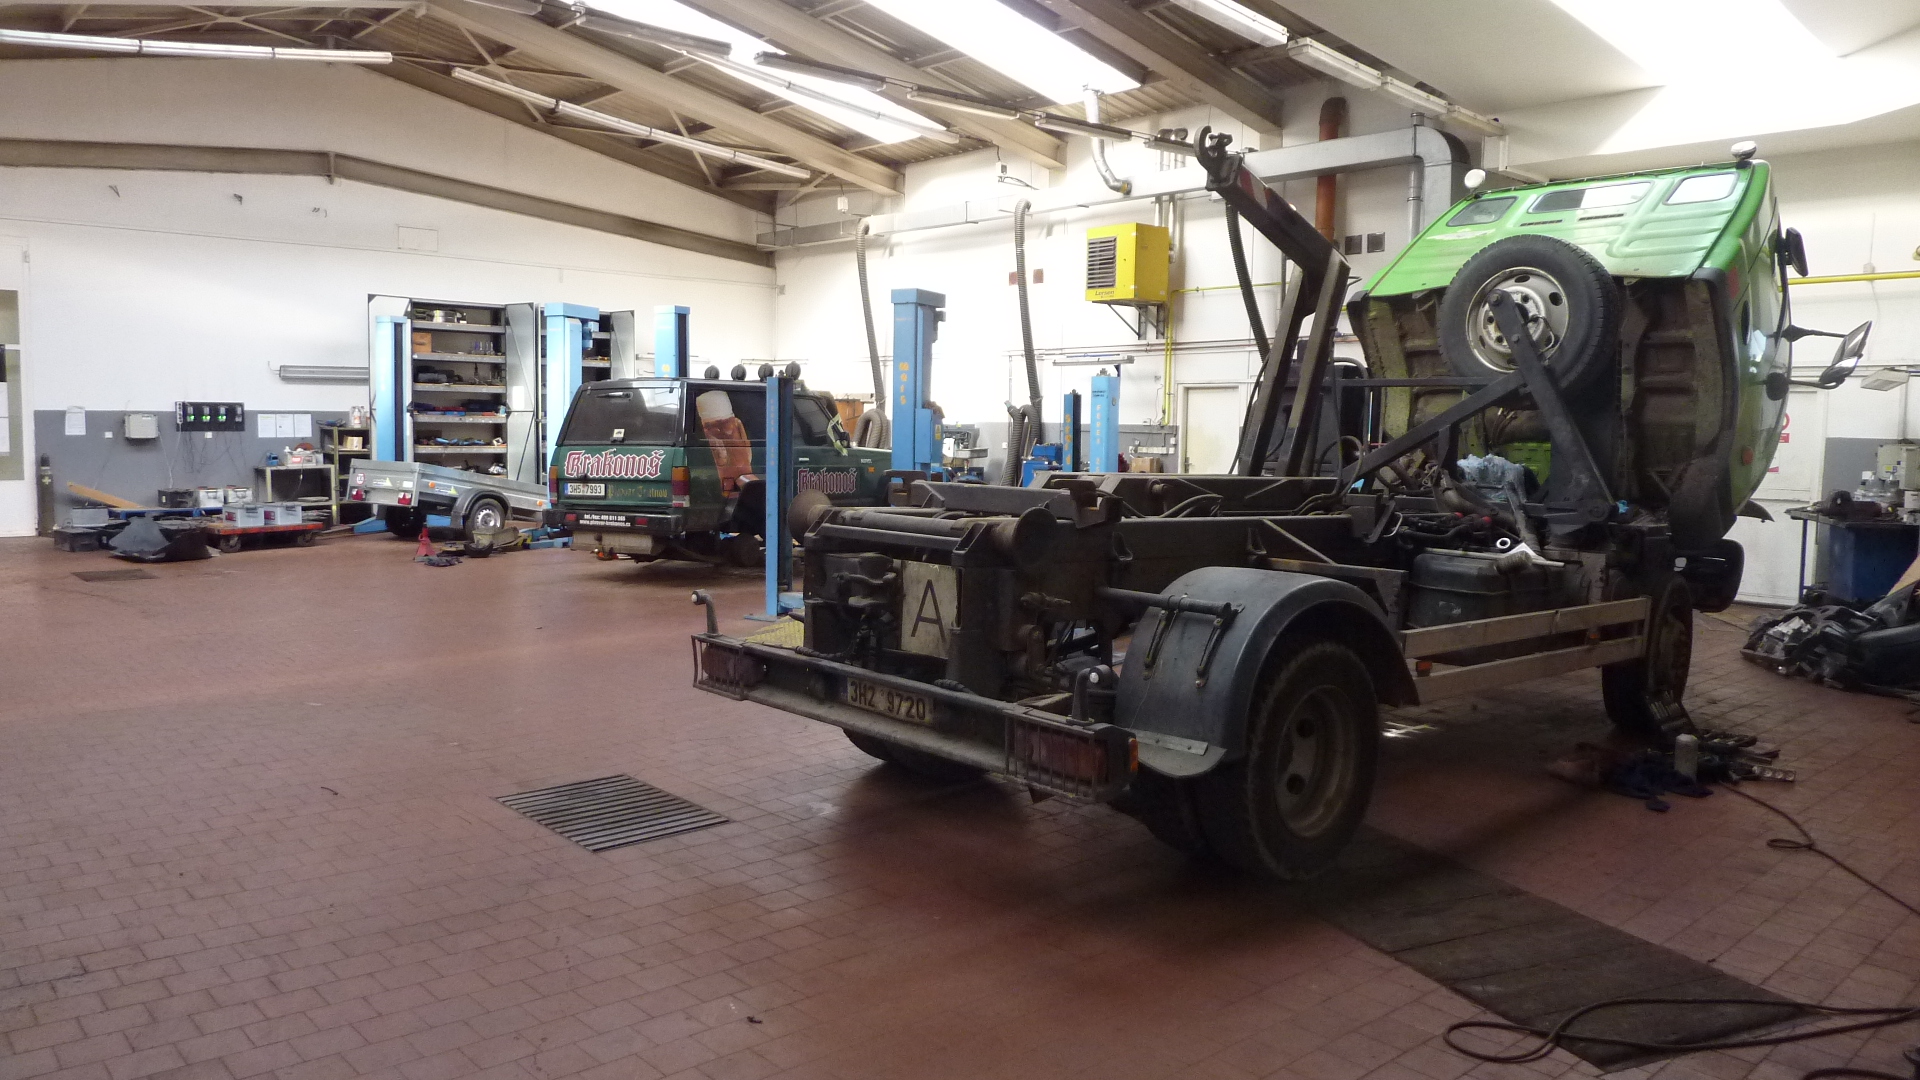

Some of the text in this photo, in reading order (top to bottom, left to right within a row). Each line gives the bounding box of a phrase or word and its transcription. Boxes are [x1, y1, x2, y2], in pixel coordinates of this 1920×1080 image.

[564, 448, 666, 478] Krakonoš
[585, 485, 602, 494] 7993
[910, 579, 947, 643] A
[850, 681, 926, 720] 3H2 9720
